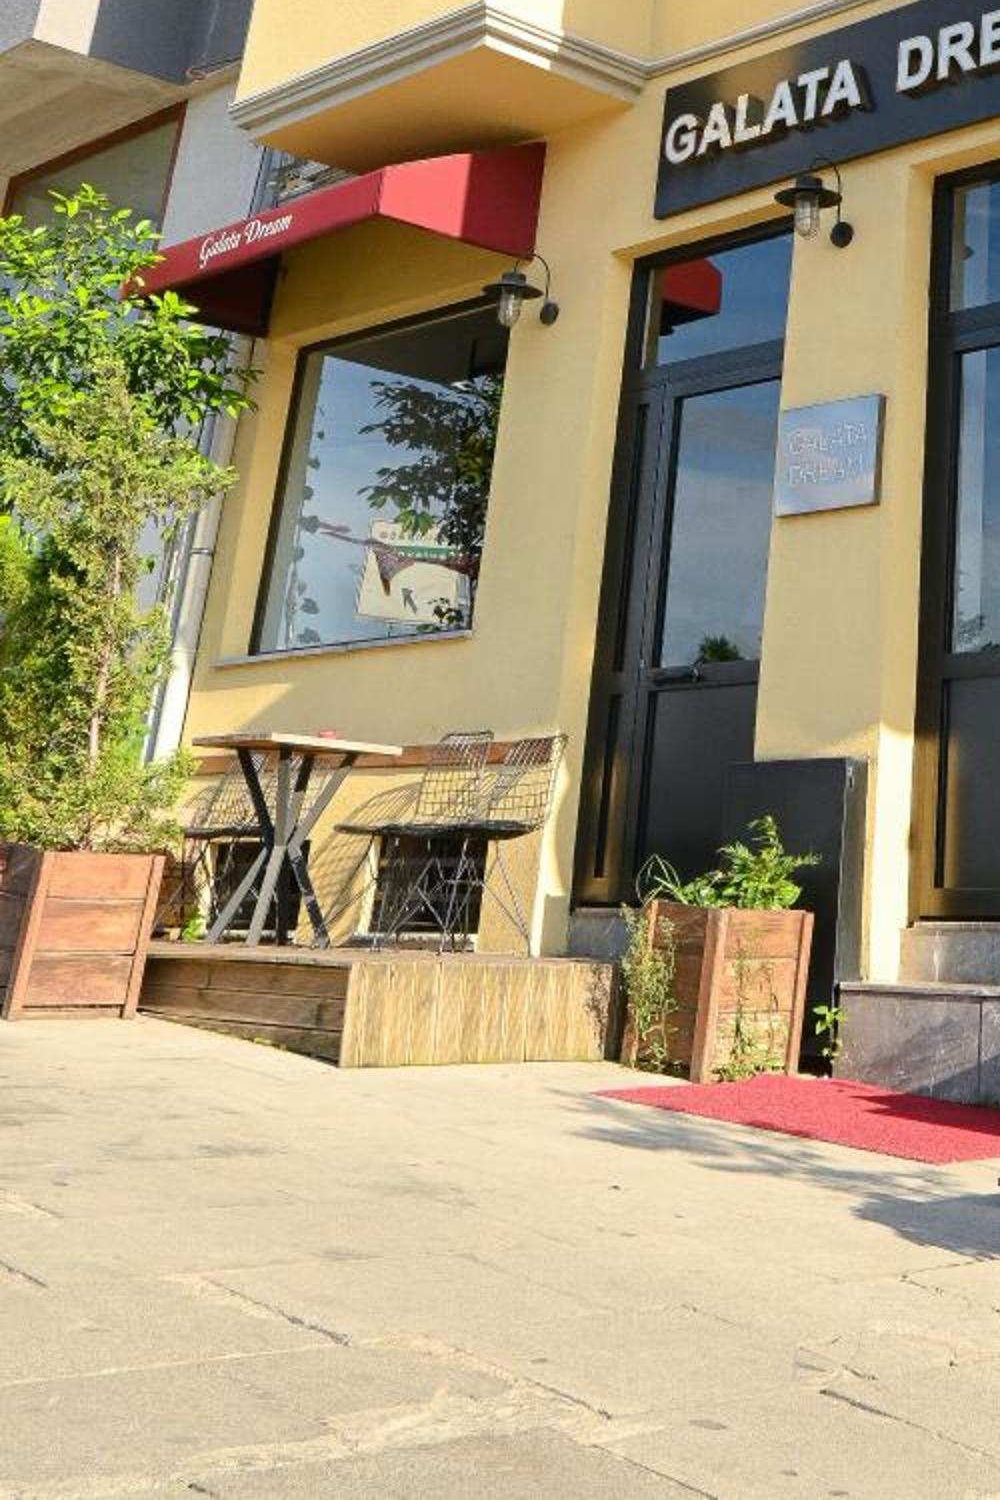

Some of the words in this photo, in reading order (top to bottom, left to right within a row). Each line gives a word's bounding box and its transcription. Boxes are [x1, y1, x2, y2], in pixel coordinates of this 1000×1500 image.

[664, 59, 862, 165] GALATA
[199, 231, 241, 270] Galata
[244, 214, 293, 245] Dream
